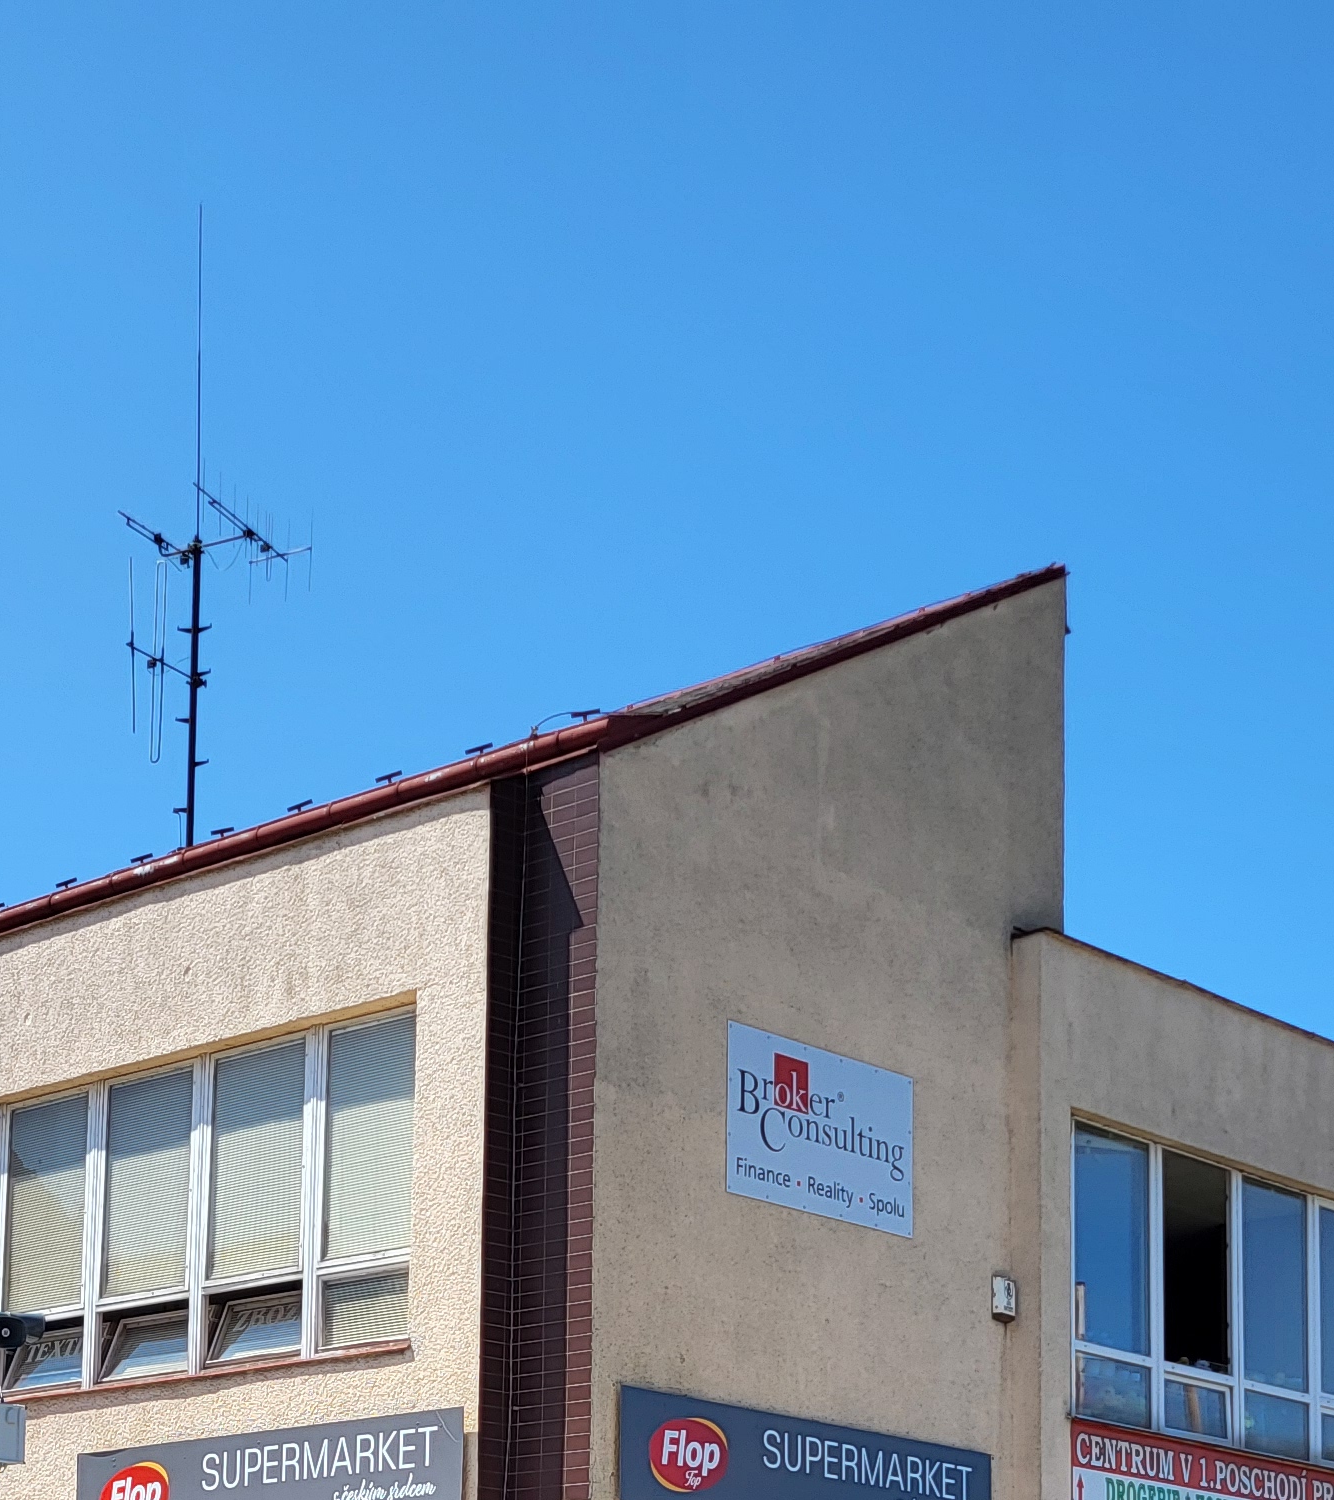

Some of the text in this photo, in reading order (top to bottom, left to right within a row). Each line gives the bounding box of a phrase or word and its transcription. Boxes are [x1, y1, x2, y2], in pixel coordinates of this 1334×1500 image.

[737, 1068, 835, 1119] Broker
[760, 1108, 904, 1181] Consulting
[736, 1157, 905, 1218] Finance Reality Spolu
[201, 1425, 439, 1491] SUPERMARKET
[660, 1428, 721, 1476] Flop
[1076, 1433, 1175, 1481] CENTRUM
[1179, 1453, 1193, 1484] V
[684, 1470, 702, 1489] Top
